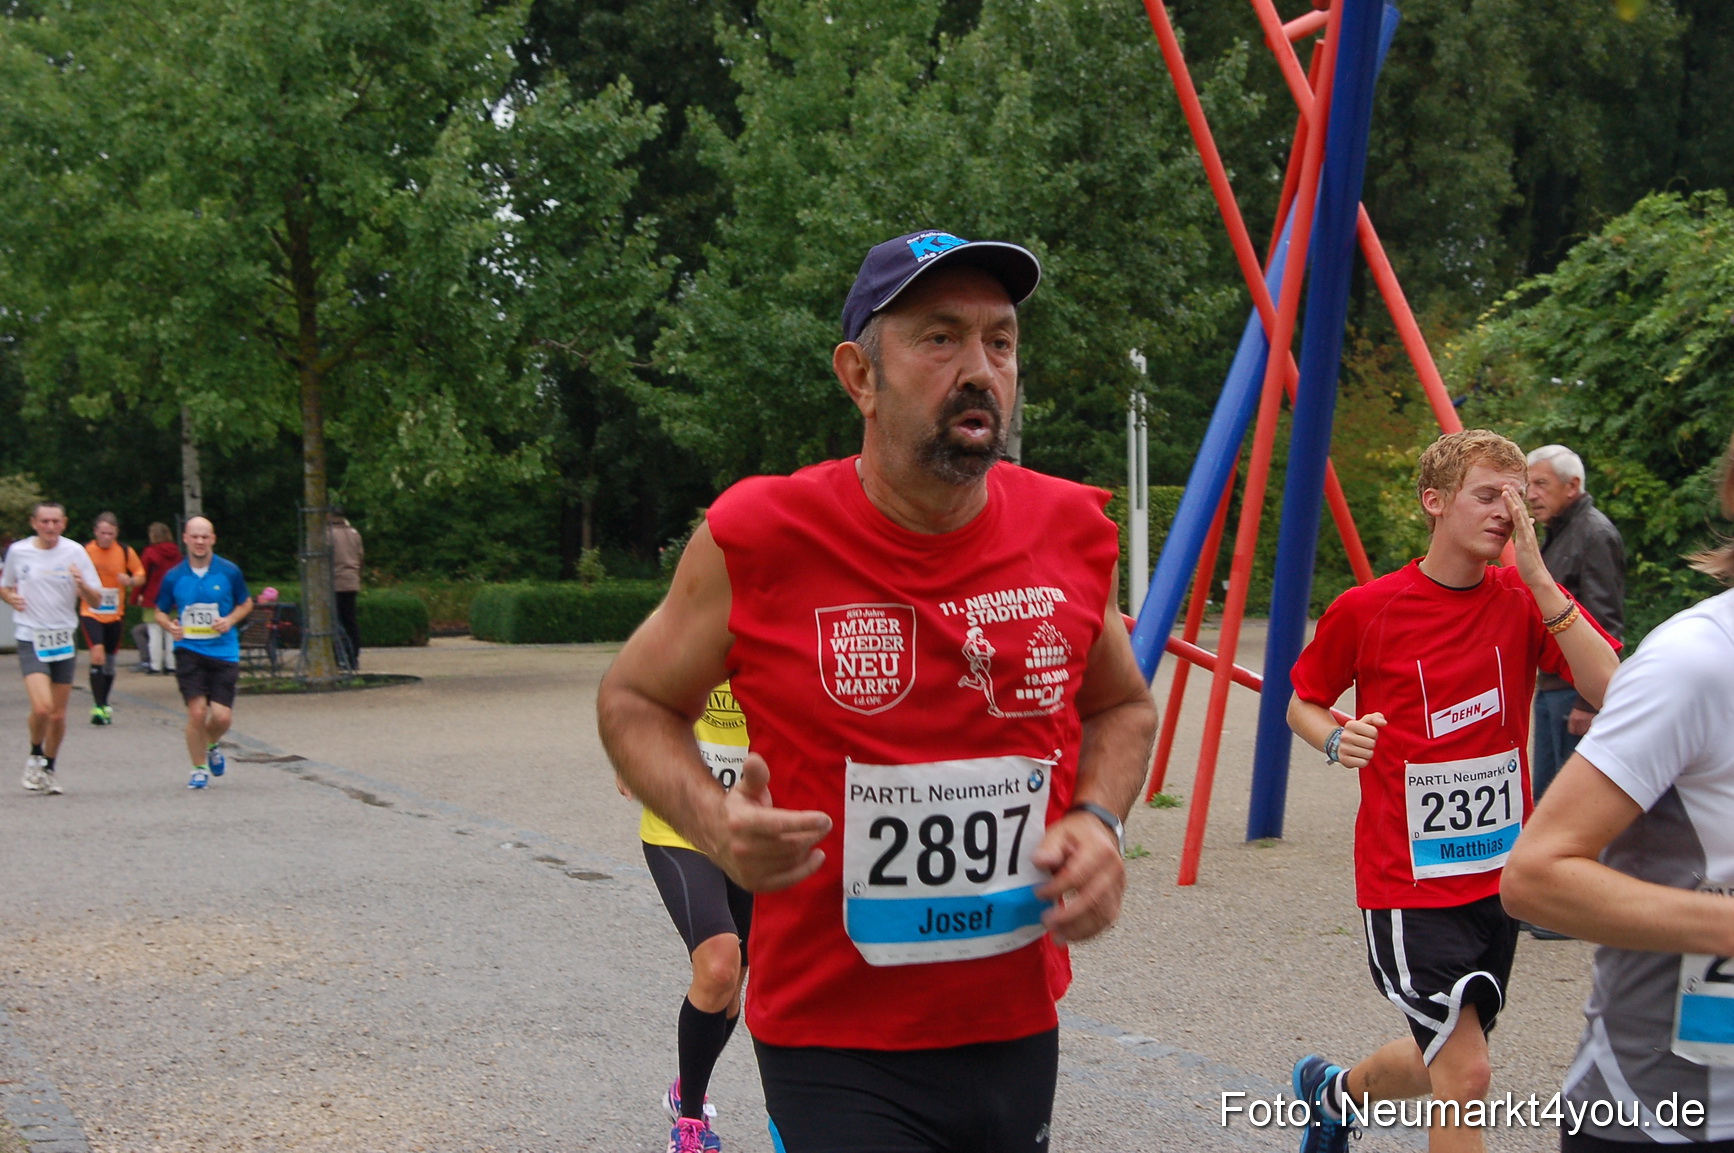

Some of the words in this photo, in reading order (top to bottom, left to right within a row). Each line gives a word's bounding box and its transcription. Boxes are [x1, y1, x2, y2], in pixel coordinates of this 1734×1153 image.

[939, 601, 965, 616] 11.
[964, 586, 1068, 611] NEUMARKTER
[190, 612, 212, 625] 130
[863, 609, 885, 618] Jahre
[966, 601, 1055, 627] STADTLAUF
[833, 618, 902, 637] IMMER
[830, 635, 905, 653] WIEDER
[834, 652, 900, 677] NEU
[835, 678, 901, 695] MARKT
[1451, 702, 1481, 724] DEHN
[1408, 774, 1450, 787] PARTL
[1454, 766, 1505, 783] Neumarkt
[850, 783, 922, 804] PARTL
[928, 778, 1020, 802] Neumarkt
[1421, 780, 1511, 833] 2321
[868, 804, 1031, 887] 2897
[1440, 840, 1504, 859] Matthias
[918, 905, 994, 935] Josef
